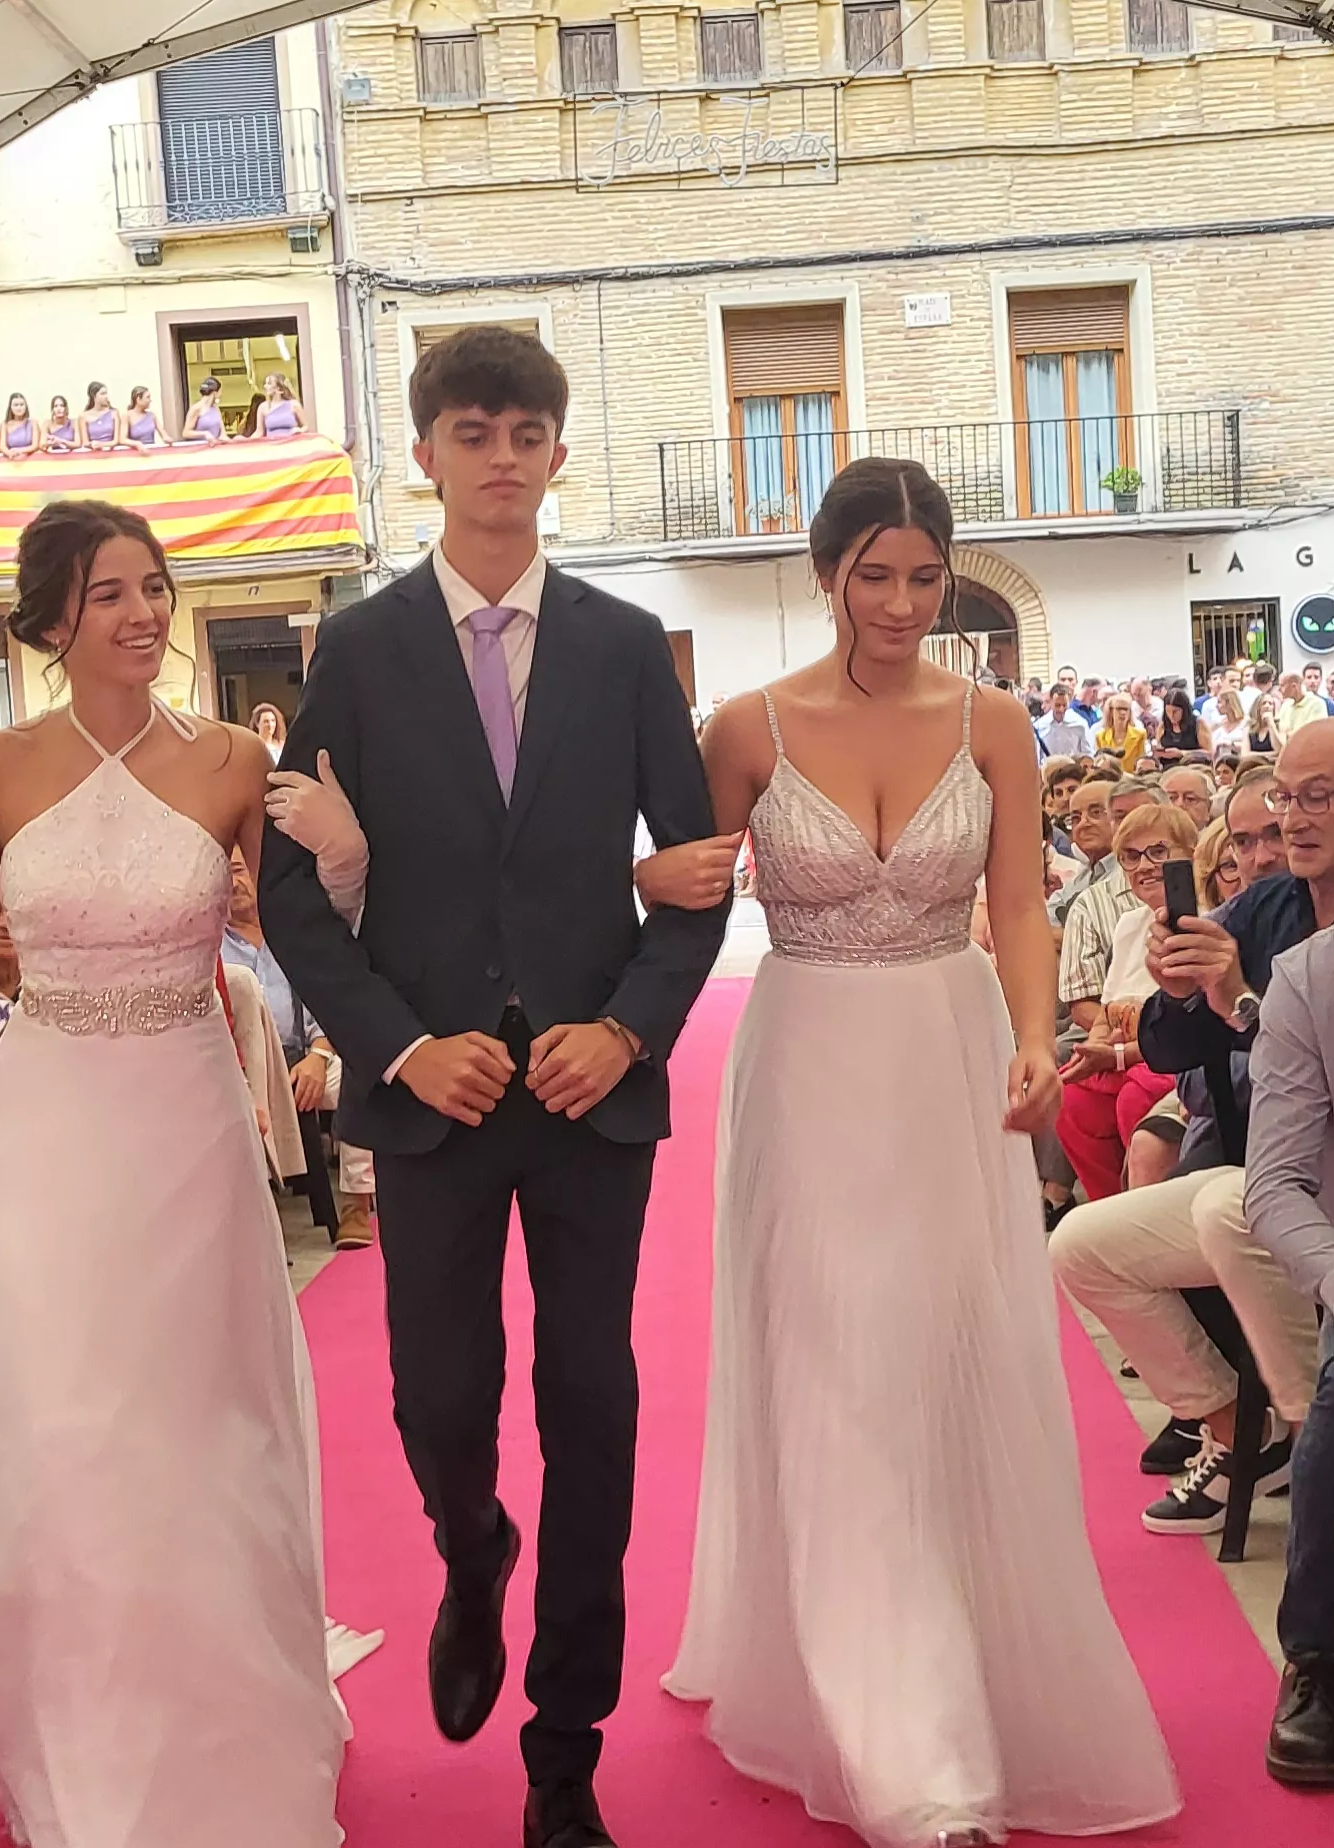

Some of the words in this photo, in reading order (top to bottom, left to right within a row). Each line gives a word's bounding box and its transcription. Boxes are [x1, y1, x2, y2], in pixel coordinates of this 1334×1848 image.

[579, 95, 723, 186] Felices
[719, 97, 837, 187] Fiestas
[1188, 550, 1244, 574] LA
